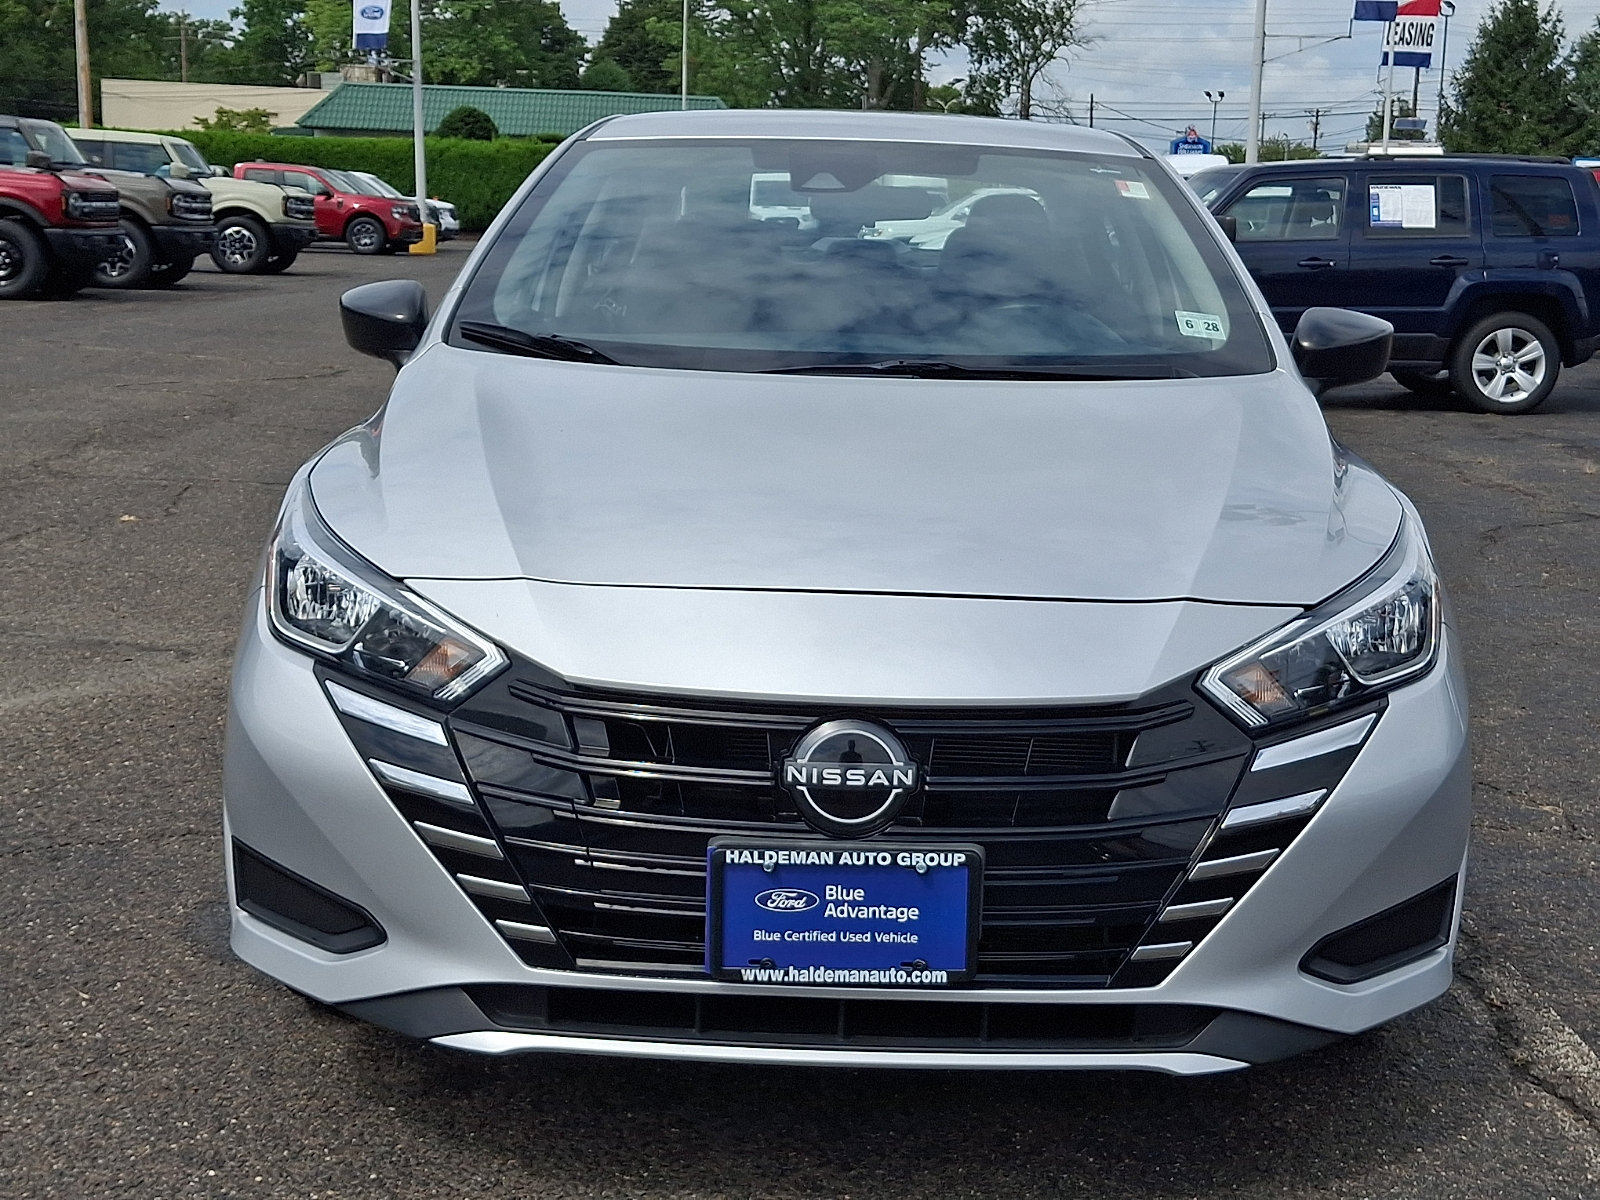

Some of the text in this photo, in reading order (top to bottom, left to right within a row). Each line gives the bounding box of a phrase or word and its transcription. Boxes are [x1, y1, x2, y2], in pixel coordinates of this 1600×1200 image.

[1386, 22, 1435, 47] LEASING
[1185, 319, 1220, 332] 6 28
[787, 765, 913, 786] NISSAN
[725, 850, 966, 867] HALDEMAN AUTO GROUP
[767, 885, 865, 909] Ford Blue
[824, 903, 920, 922] Advantage
[753, 930, 918, 944] Blue Certified Used Vehicle
[741, 966, 948, 984] www.haldemanauto.com
